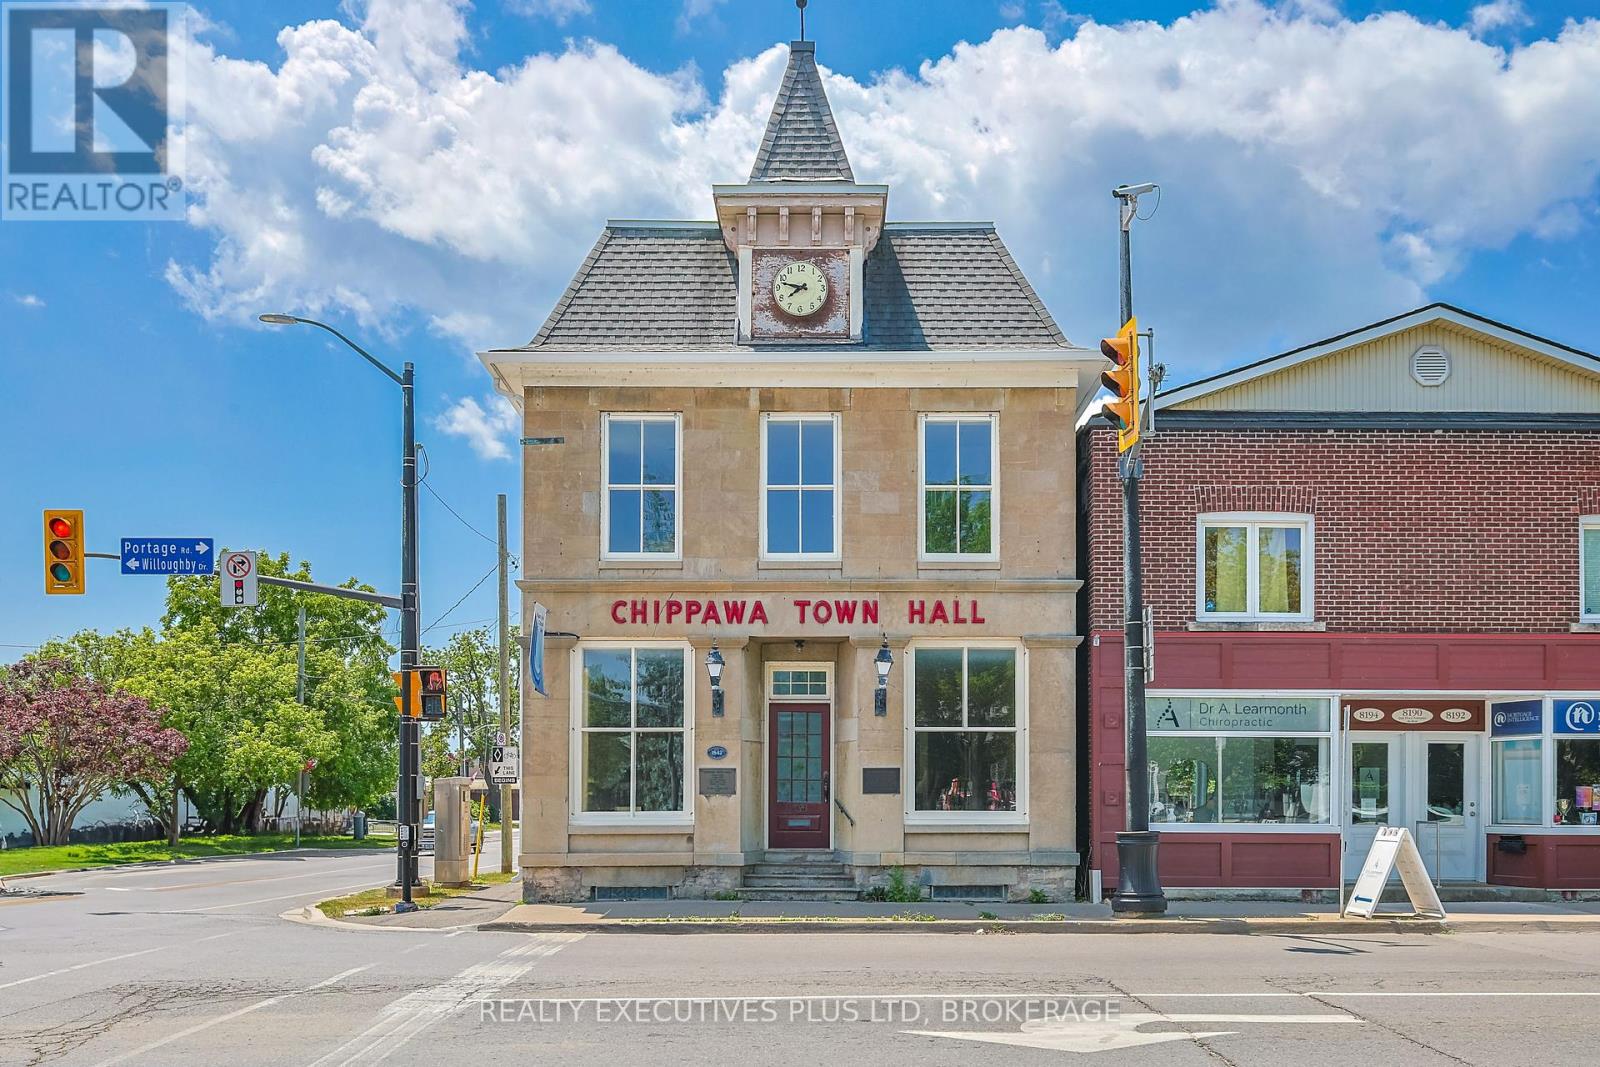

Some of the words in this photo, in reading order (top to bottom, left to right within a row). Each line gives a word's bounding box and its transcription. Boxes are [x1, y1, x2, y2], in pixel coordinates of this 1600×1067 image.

[787, 267, 793, 275] 11
[812, 267, 815, 275] 1
[818, 275, 823, 283] 2
[821, 285, 826, 293] 3
[779, 294, 784, 302] 8
[817, 295, 822, 303] 4
[810, 302, 815, 310] 5
[124, 542, 176, 556] Portage
[180, 547, 193, 555] Rd.
[141, 558, 196, 573] Willoughby
[610, 599, 769, 625] CHIPPAWA
[793, 599, 879, 625] TOWN
[908, 599, 986, 624] HALL
[1199, 703, 1213, 715] Dr
[1218, 703, 1231, 715] A.
[1235, 703, 1308, 716] Learmonth
[1402, 709, 1423, 717] 8190
[1359, 711, 1379, 719] 8194
[1445, 711, 1466, 719] 8192
[1199, 717, 1273, 729] Chiropractic
